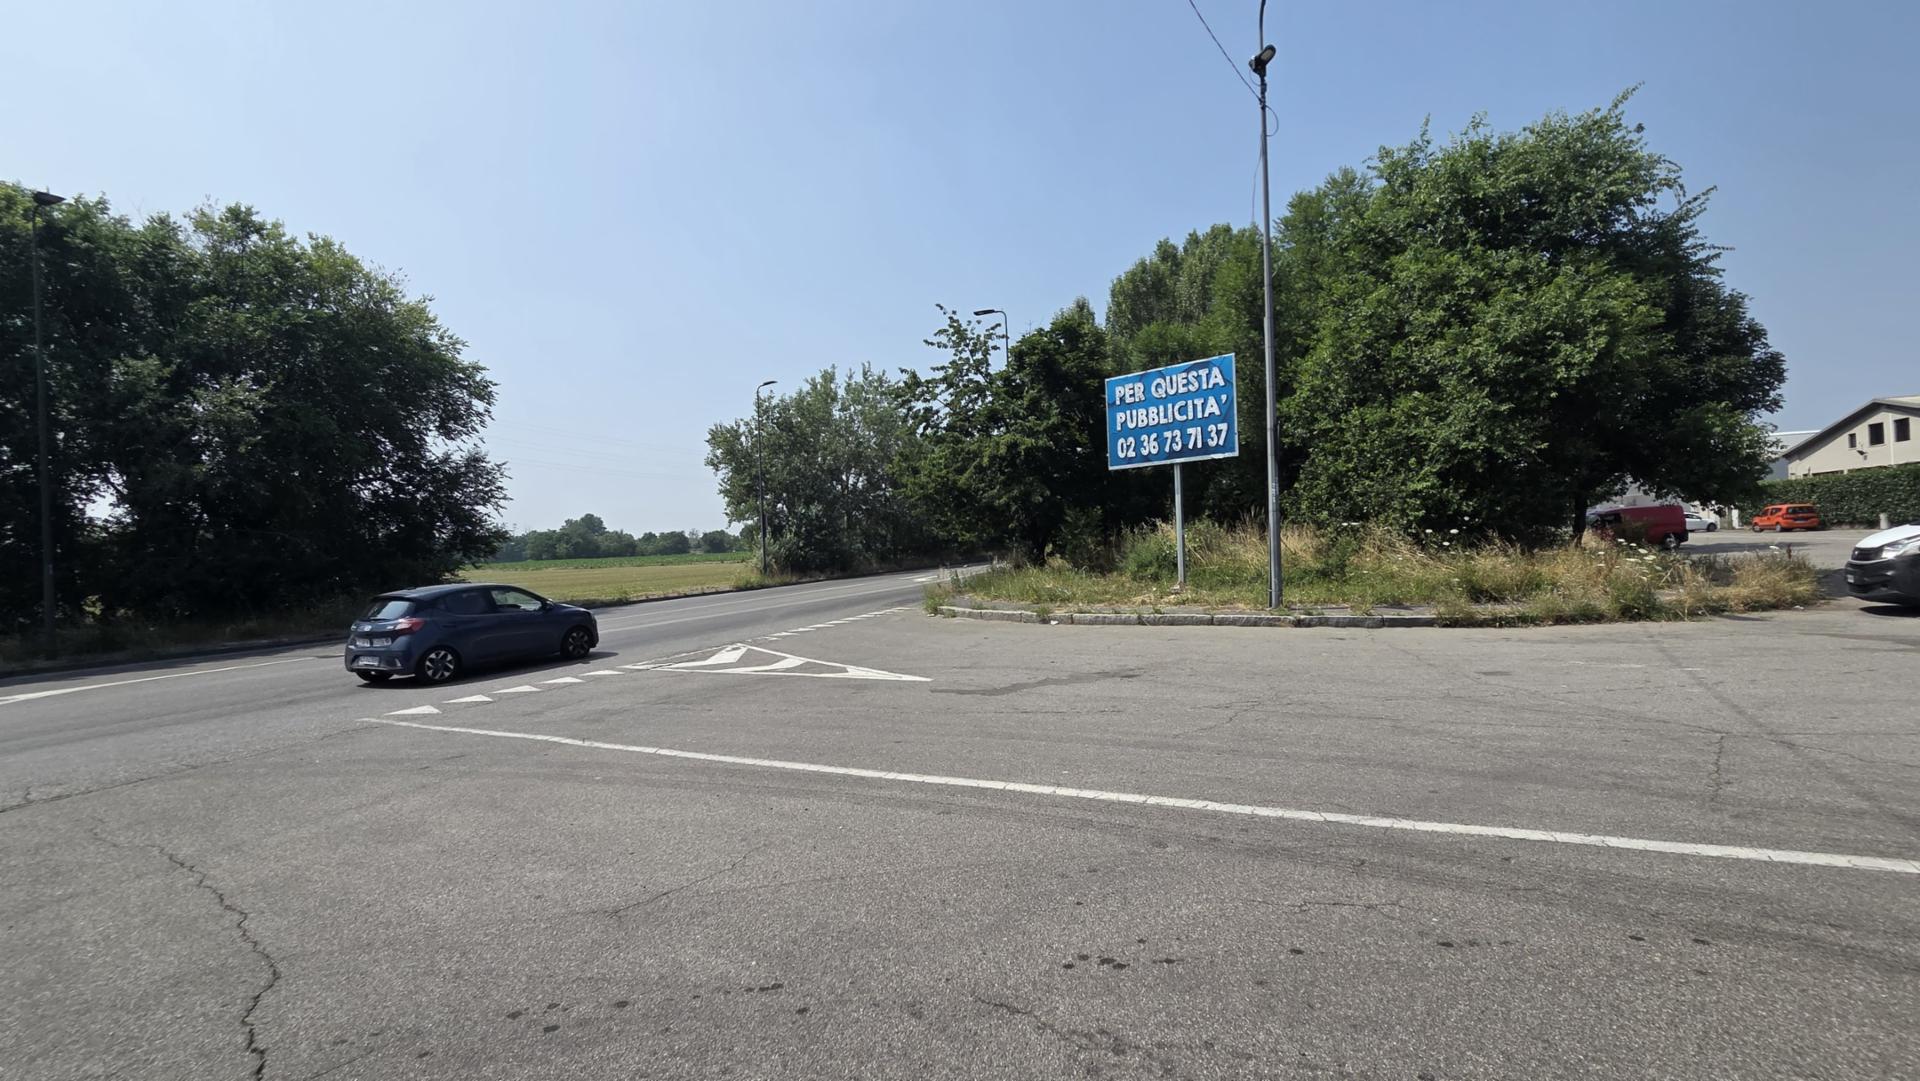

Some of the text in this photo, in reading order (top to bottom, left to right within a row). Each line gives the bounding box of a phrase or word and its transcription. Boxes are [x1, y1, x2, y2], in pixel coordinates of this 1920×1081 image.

[1115, 367, 1225, 405] PER QUESTA
[1117, 423, 1228, 458] 02 36 73 71 37
